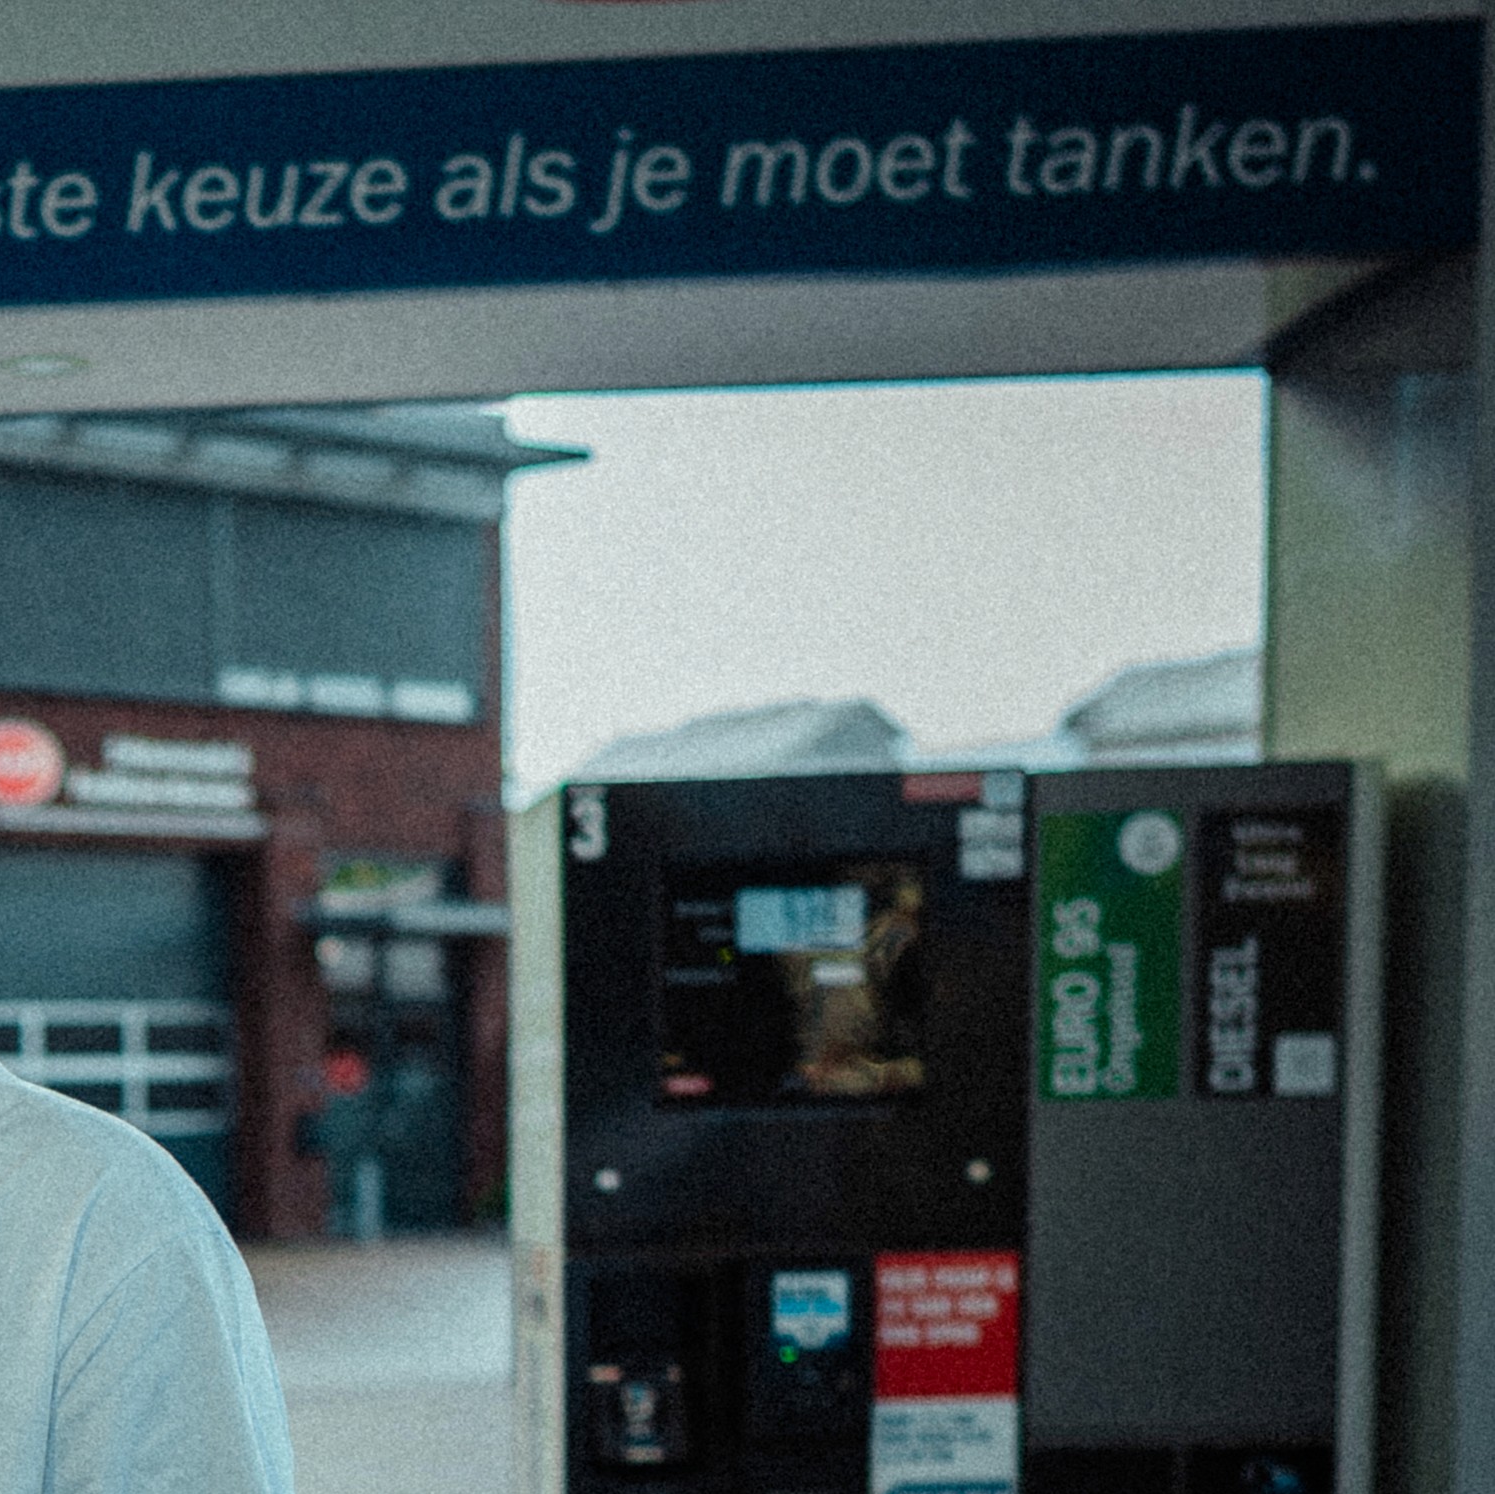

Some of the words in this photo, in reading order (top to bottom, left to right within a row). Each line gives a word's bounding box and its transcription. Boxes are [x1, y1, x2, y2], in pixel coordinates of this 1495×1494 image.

[126, 151, 409, 234] keuze
[435, 133, 578, 220] als
[590, 128, 690, 233] je
[720, 117, 975, 207] moet
[1006, 104, 1379, 196] tanken.
[568, 795, 606, 861] 3
[1051, 971, 1101, 1096] EURO
